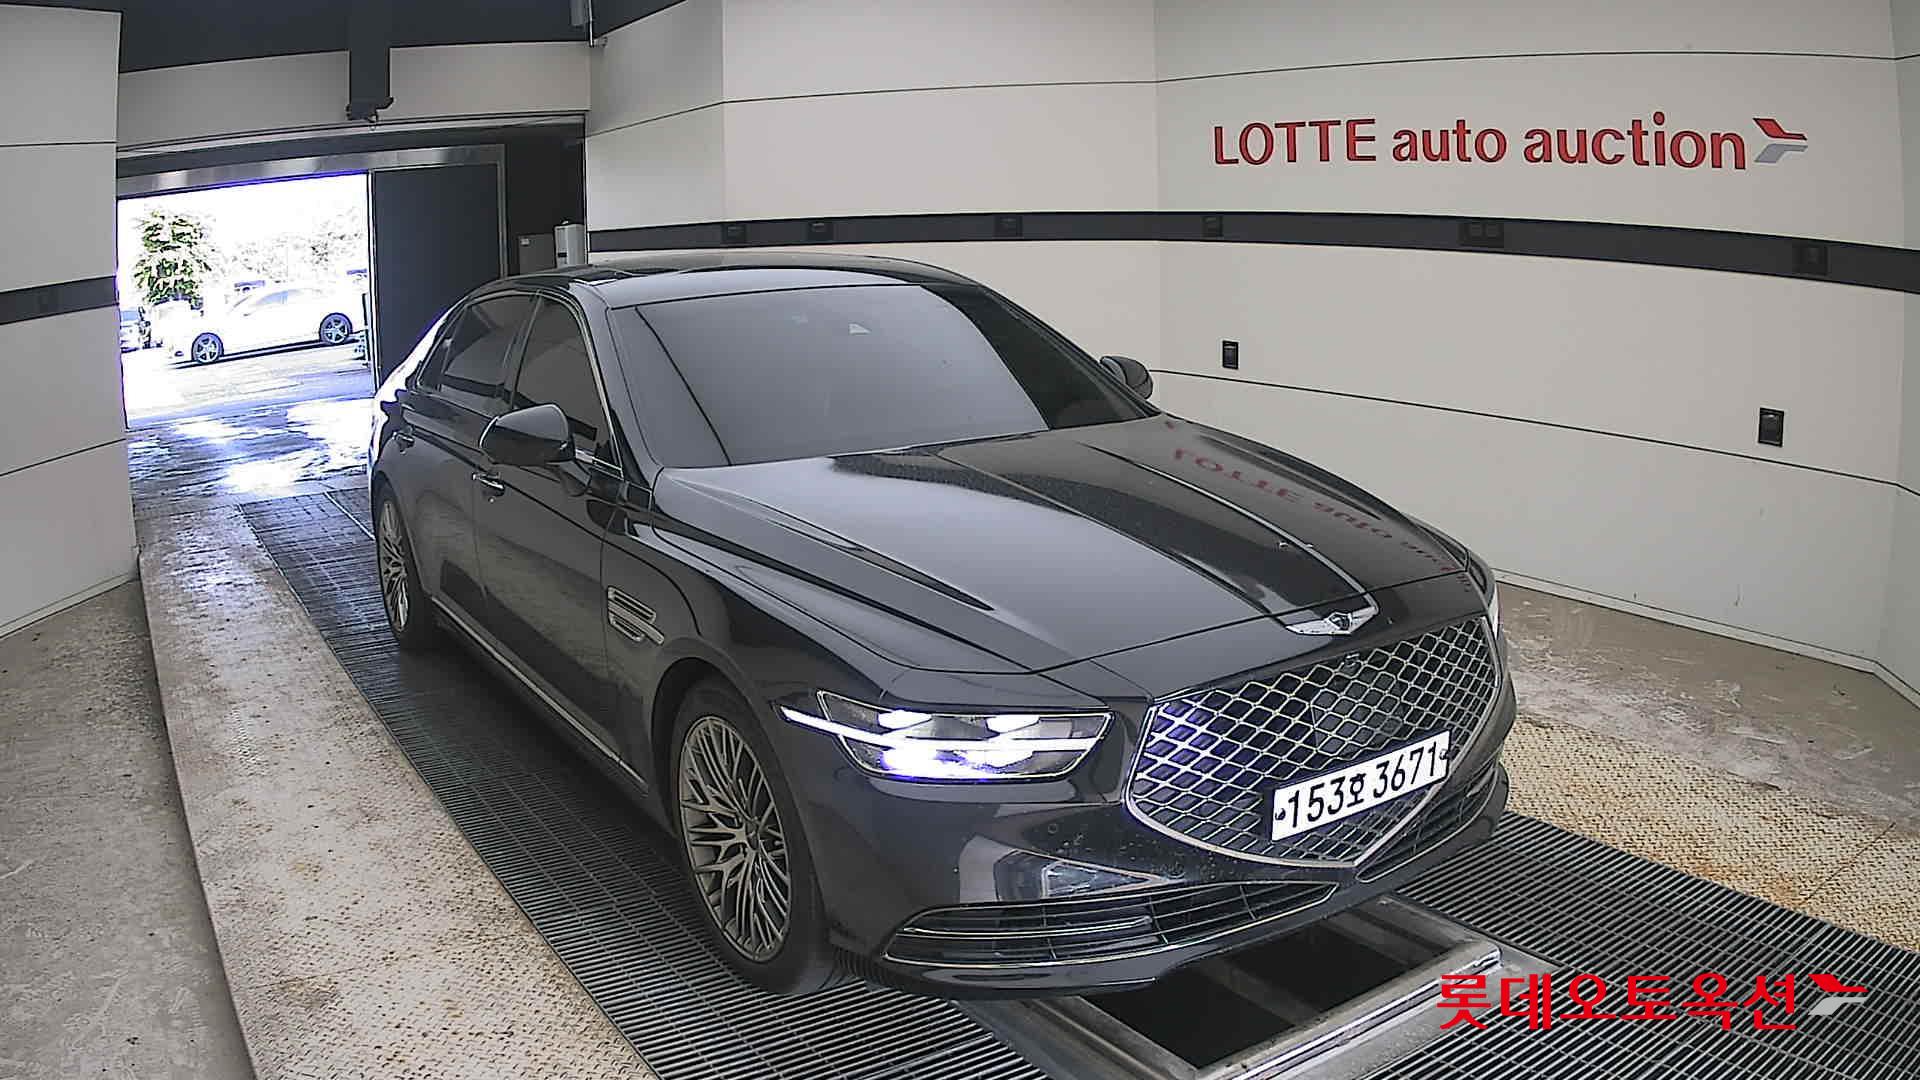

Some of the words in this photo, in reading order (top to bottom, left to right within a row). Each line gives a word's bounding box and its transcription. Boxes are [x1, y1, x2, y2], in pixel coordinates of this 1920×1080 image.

[1214, 118, 1377, 166] LOTTE
[1392, 119, 1507, 163] auto
[1523, 111, 1746, 170] auction
[1287, 773, 1367, 828] 153호
[1373, 741, 1437, 798] 3671
